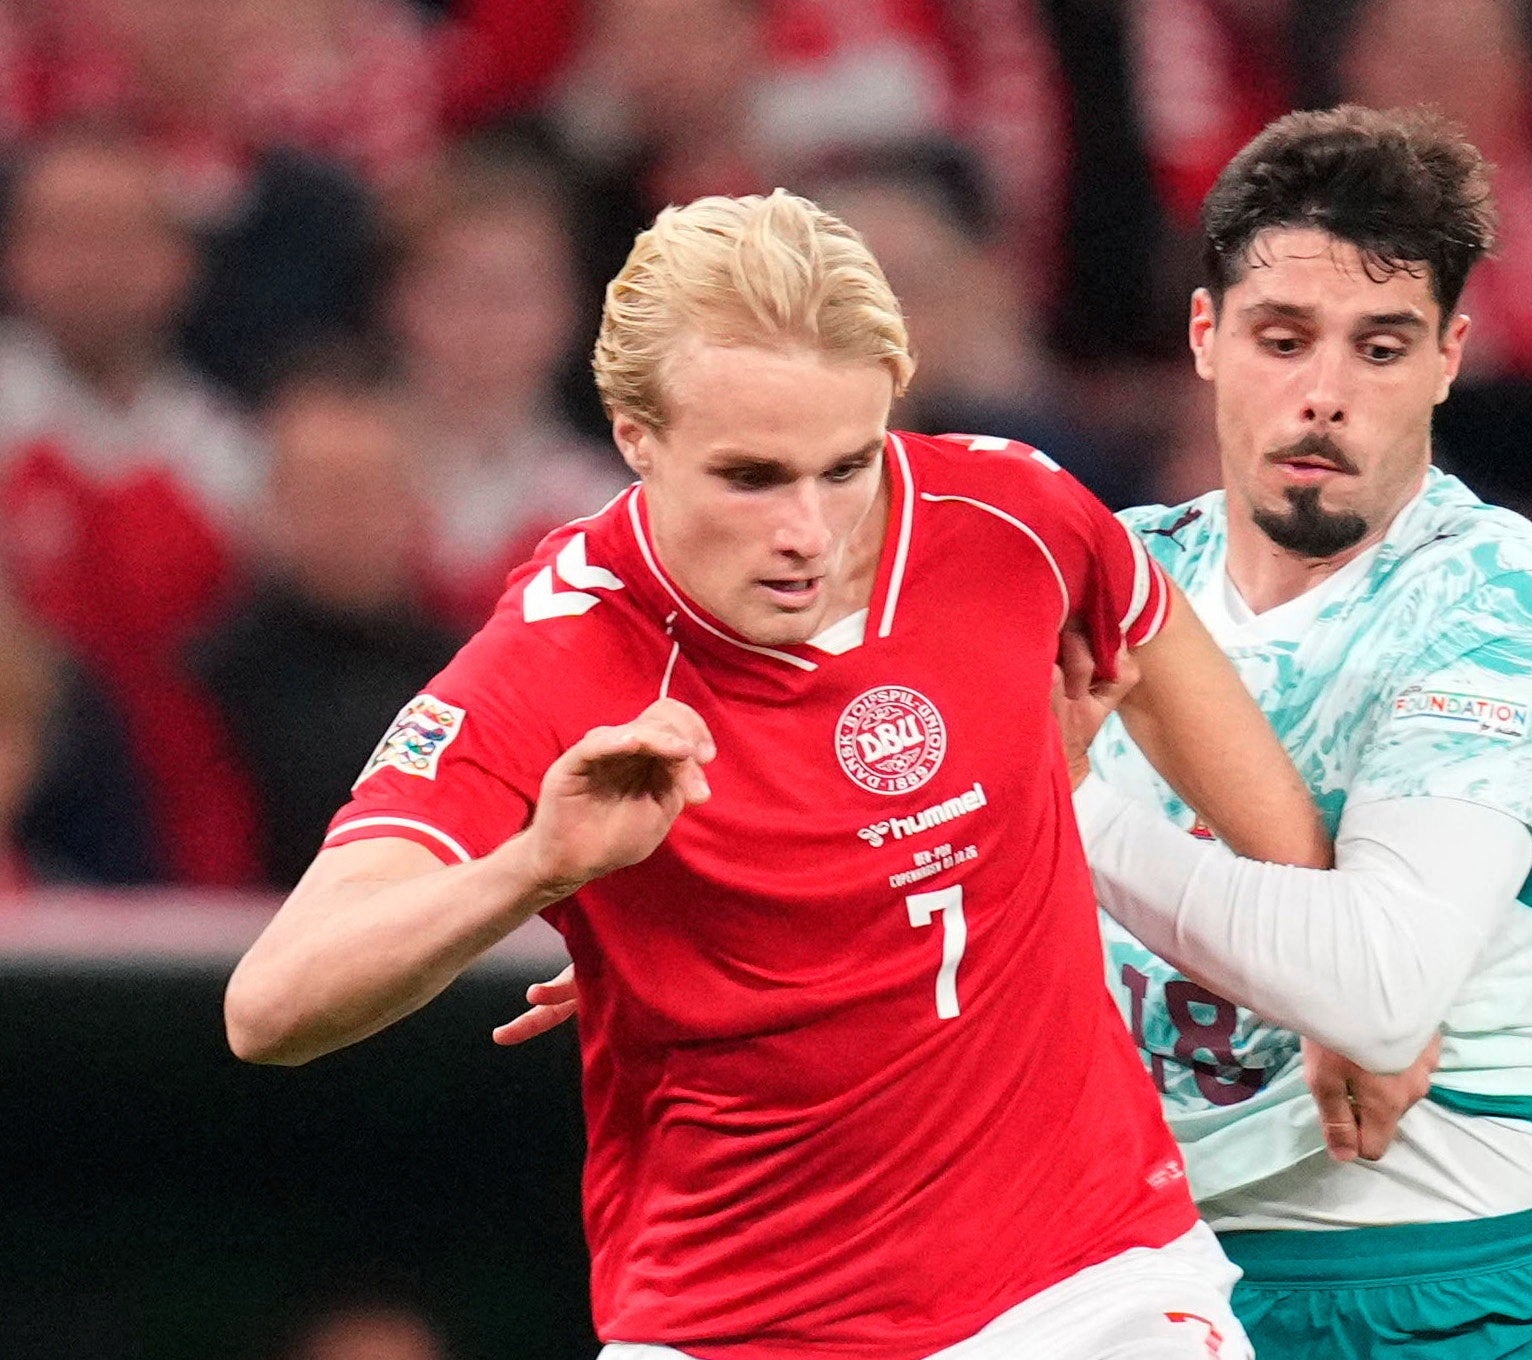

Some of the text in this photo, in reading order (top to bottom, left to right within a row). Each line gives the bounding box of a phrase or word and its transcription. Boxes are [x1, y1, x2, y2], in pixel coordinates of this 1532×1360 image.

[856, 714, 925, 763] DBU
[889, 782, 987, 839] hummel
[906, 884, 968, 1019] 7
